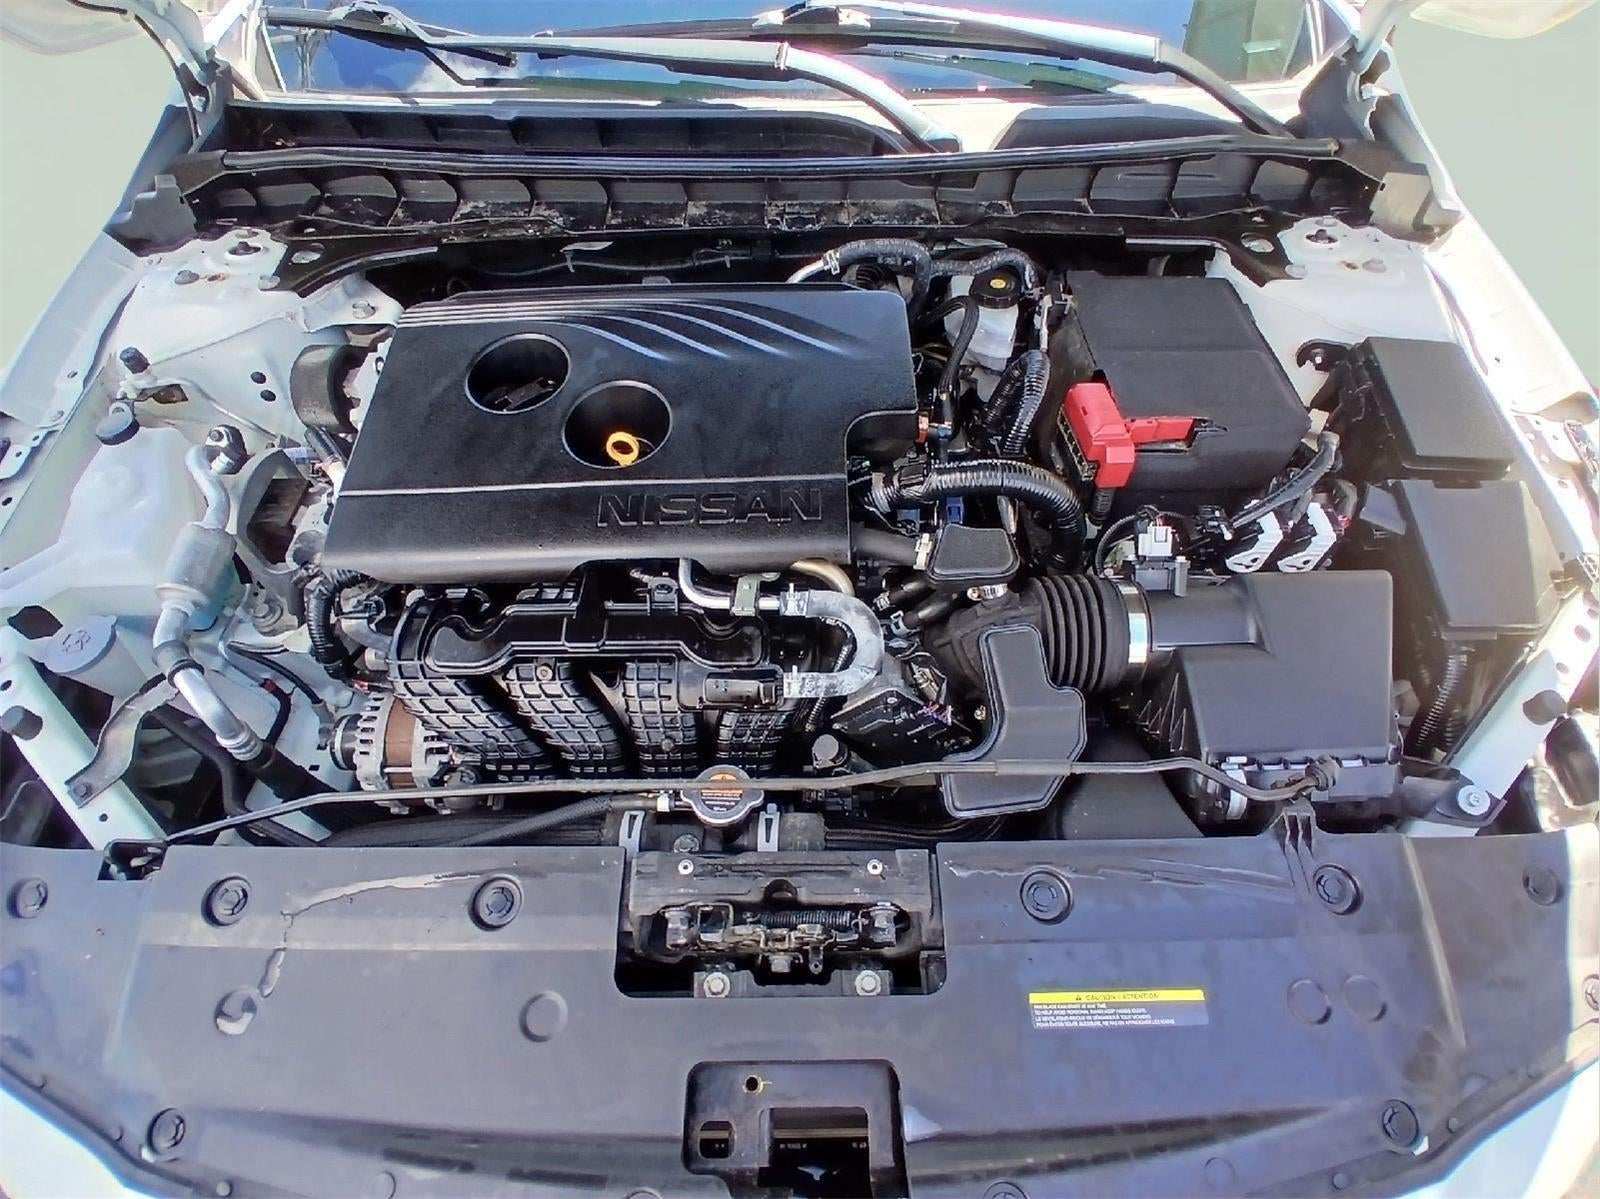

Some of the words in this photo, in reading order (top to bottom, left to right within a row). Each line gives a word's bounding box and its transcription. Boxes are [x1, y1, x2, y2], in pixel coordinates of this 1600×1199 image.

[596, 487, 822, 528] NISSAN
[1085, 993, 1115, 1001] CAUTION
[1122, 992, 1159, 1000] ATTENTION
